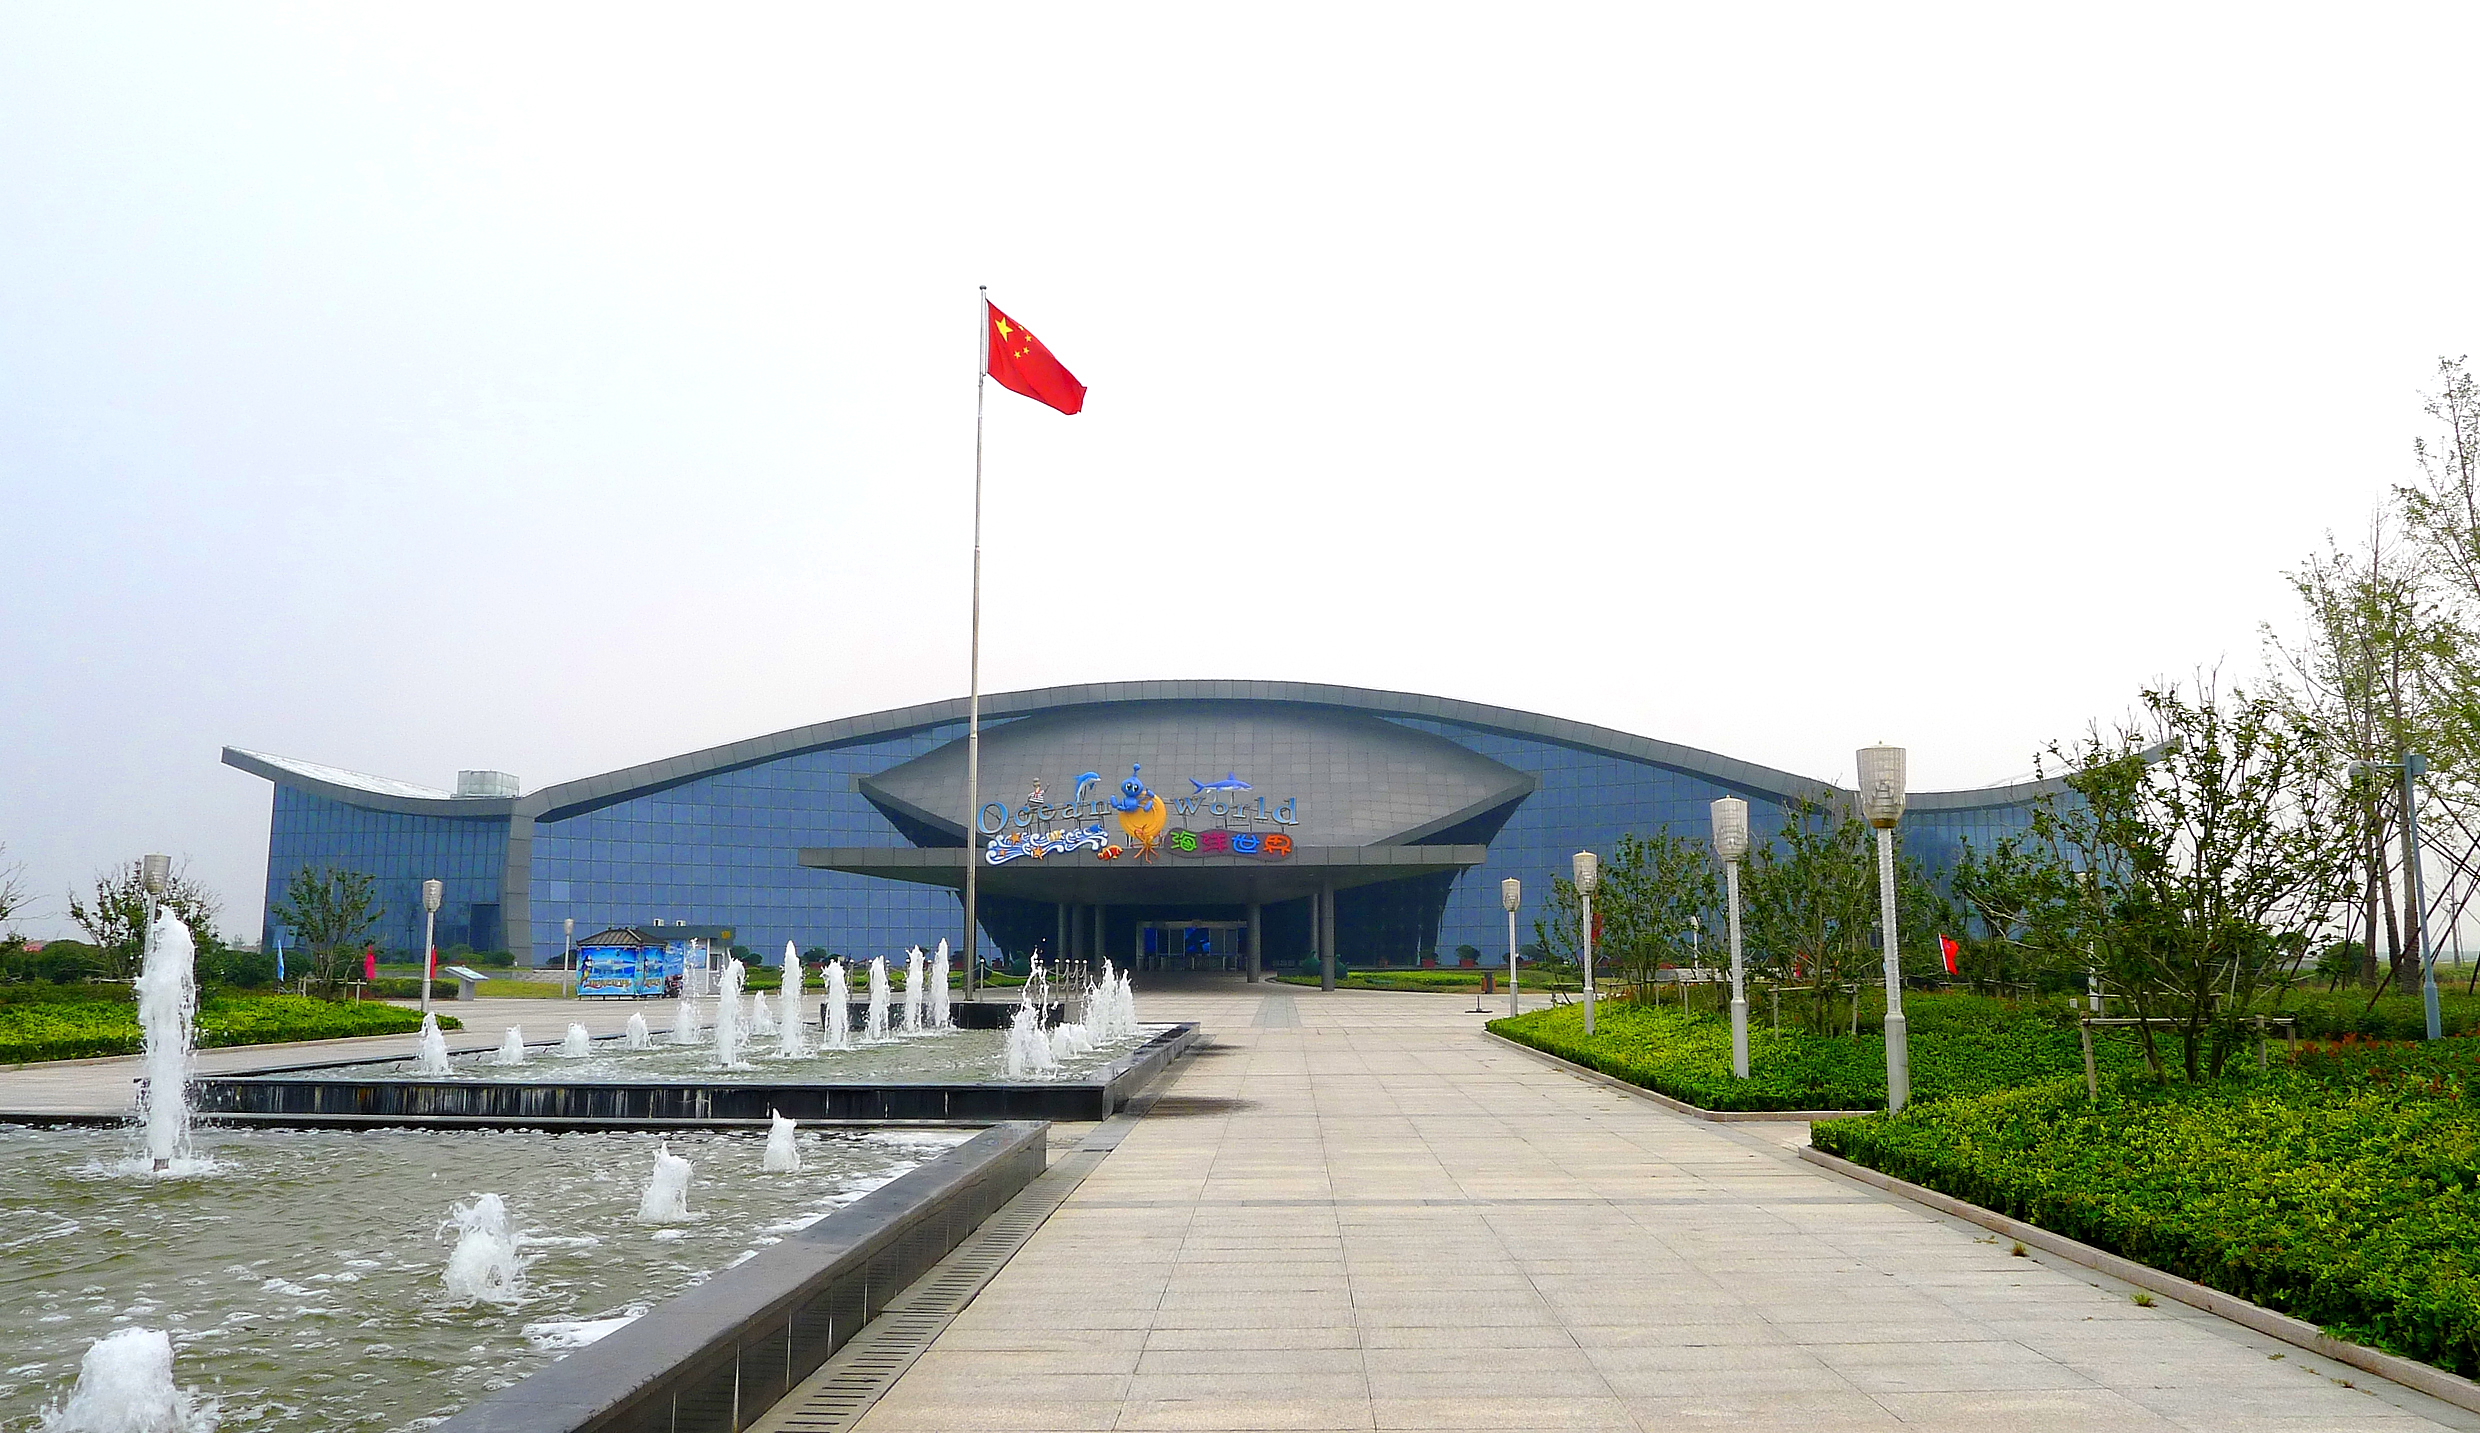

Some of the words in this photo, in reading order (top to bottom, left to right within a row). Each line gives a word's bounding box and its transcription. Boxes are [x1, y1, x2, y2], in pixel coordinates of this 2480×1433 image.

[977, 800, 1111, 835] Ocean
[1169, 830, 1292, 856] 海洋世界
